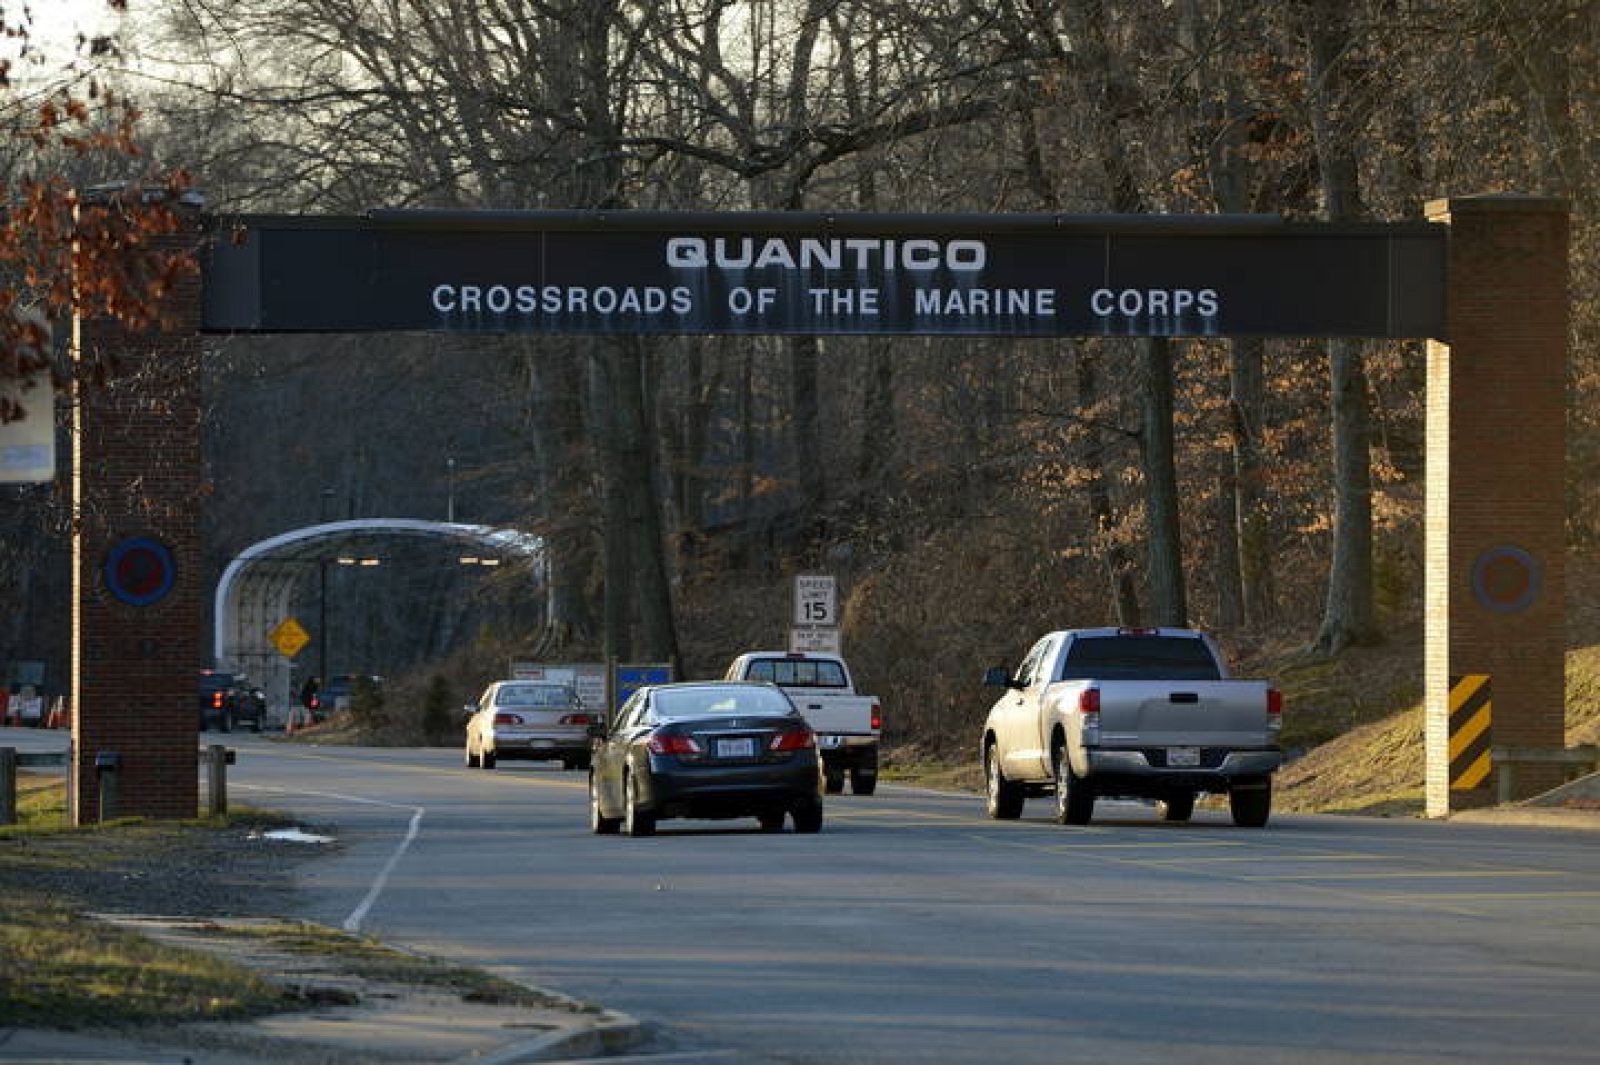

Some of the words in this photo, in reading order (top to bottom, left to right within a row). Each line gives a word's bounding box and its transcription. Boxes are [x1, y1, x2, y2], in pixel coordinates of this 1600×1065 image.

[666, 237, 987, 271] QUANTICO
[432, 284, 692, 314] CROSSROADS
[728, 288, 776, 315] OF
[808, 288, 879, 315] THE
[915, 288, 1055, 316] MARINE
[1092, 288, 1219, 317] CORPS
[804, 602, 828, 621] 15
